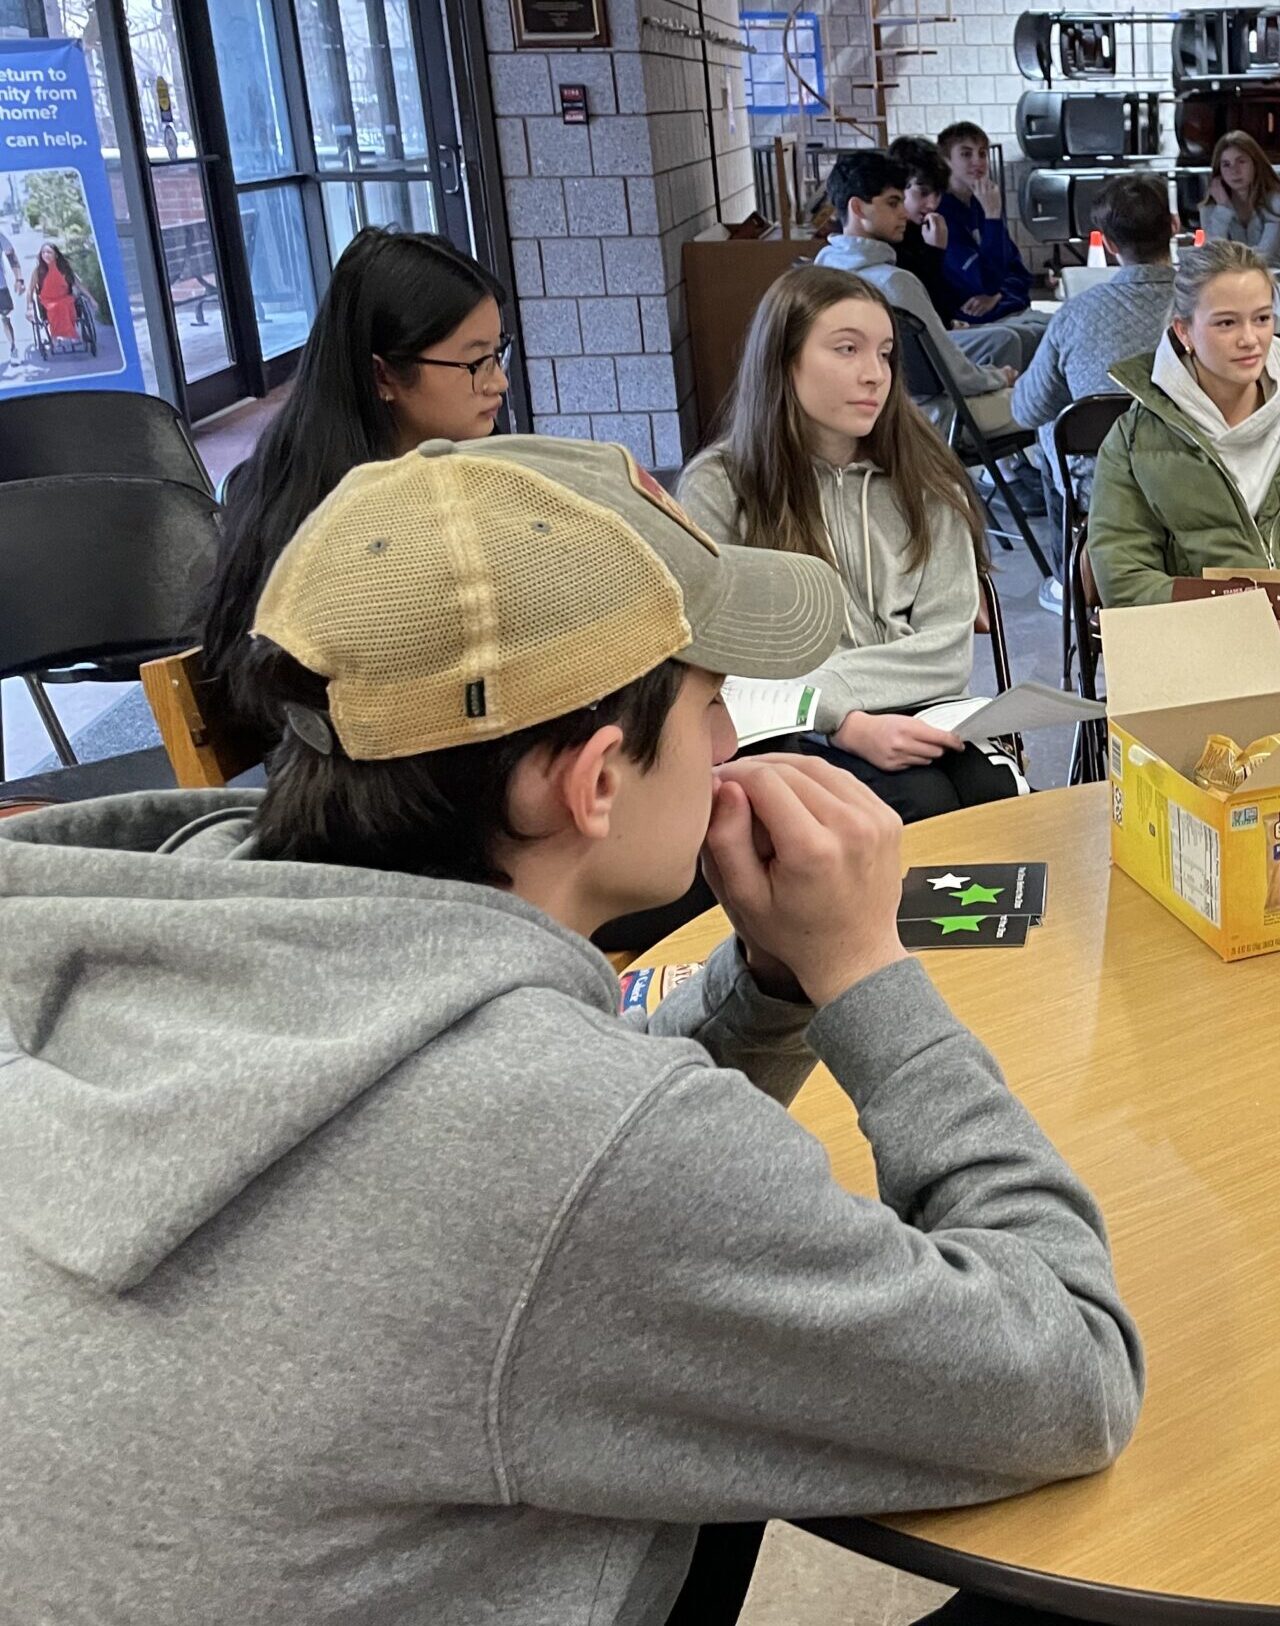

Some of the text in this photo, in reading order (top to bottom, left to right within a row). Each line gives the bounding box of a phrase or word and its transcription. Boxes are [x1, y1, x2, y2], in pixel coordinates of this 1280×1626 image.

[48, 67, 67, 82] to
[35, 85, 78, 101] from
[0, 104, 58, 120] home?
[6, 131, 87, 150] can help.
